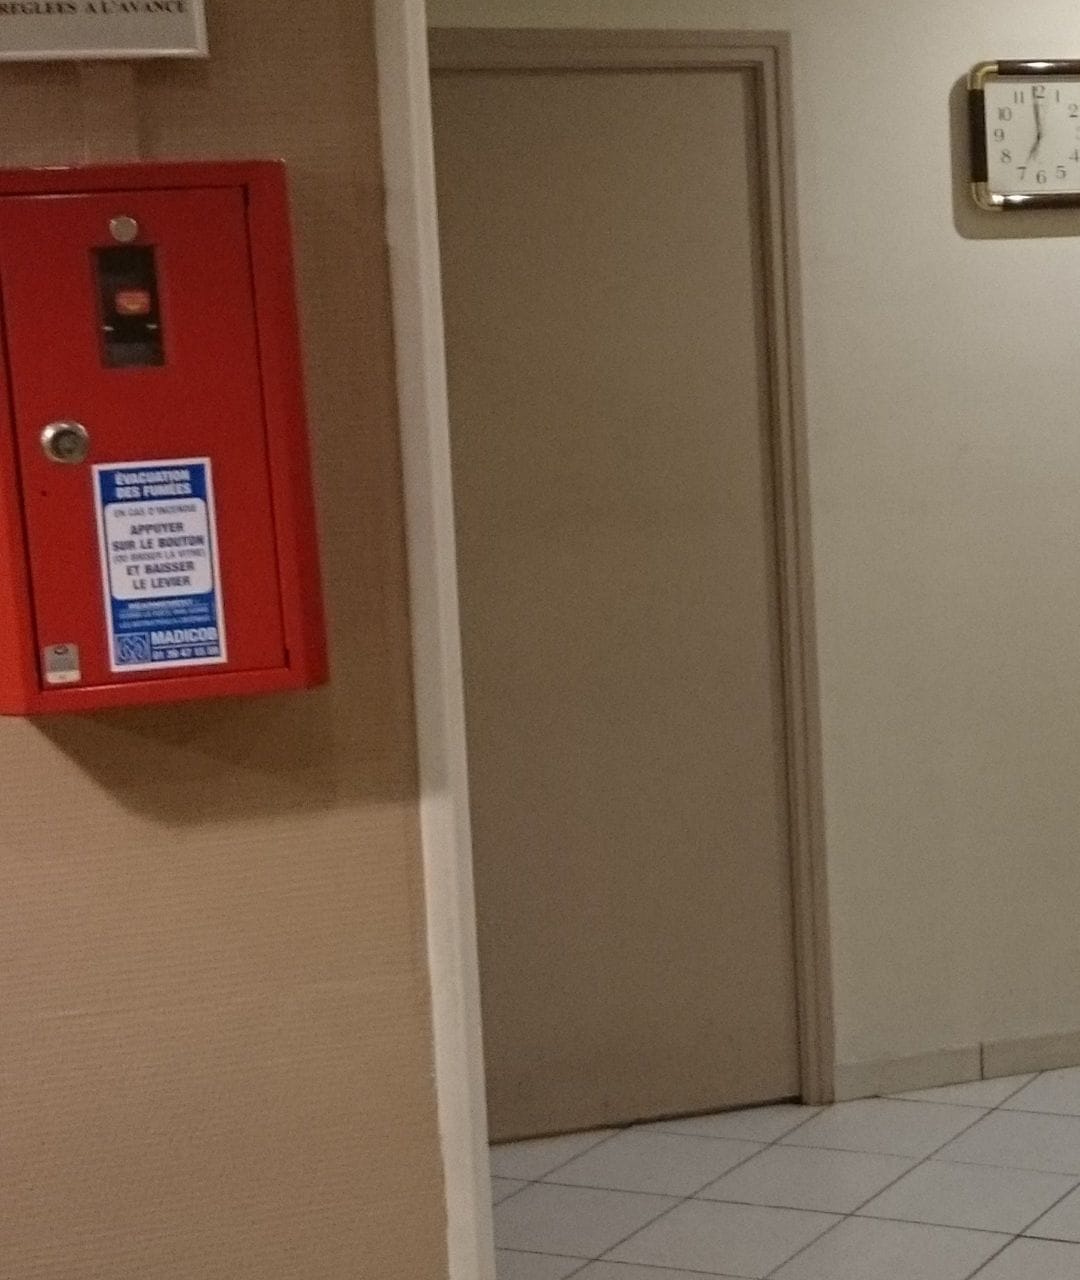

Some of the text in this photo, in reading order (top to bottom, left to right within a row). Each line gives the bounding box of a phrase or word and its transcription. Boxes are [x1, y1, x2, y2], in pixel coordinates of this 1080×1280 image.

[101, 0, 188, 14] L'AVANCE
[1014, 91, 1025, 104] 11
[1032, 85, 1045, 99] 12
[1054, 89, 1060, 102] 1
[998, 107, 1012, 121] 10
[1068, 104, 1078, 118] 2
[993, 128, 1005, 142] 9
[1001, 149, 1012, 163] 8
[1069, 149, 1080, 162] 4
[1017, 166, 1027, 180] 7
[1036, 170, 1047, 184] 6
[1057, 165, 1067, 179] 5
[115, 486, 141, 499] DES
[130, 522, 184, 535] APPUYER
[112, 535, 204, 551] SUR LE BOUTON
[126, 561, 194, 576] ET BAISSER
[132, 575, 191, 590] LE LEVIER
